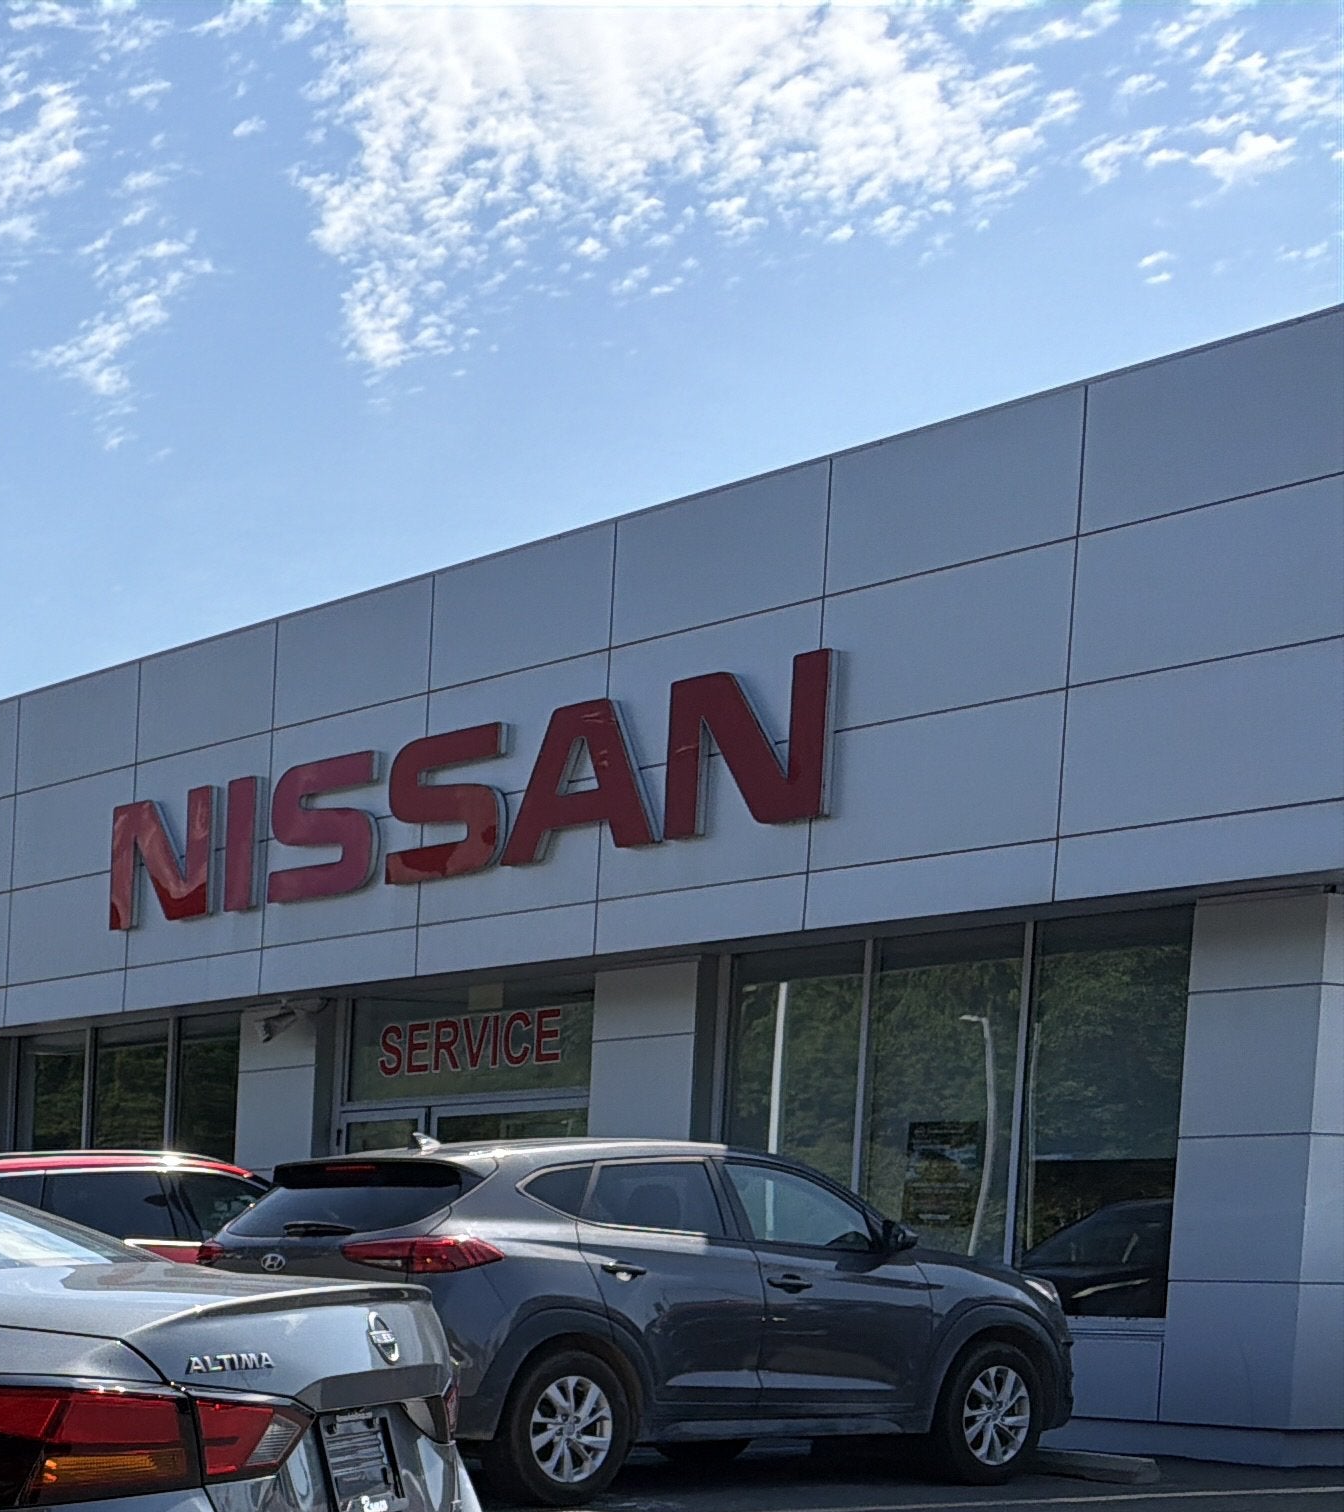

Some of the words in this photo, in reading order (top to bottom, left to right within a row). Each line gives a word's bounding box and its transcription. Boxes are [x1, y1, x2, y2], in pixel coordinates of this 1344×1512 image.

[108, 648, 837, 931] NISSAN
[378, 1008, 562, 1078] SERVICE
[187, 1352, 275, 1374] ALTIMA
